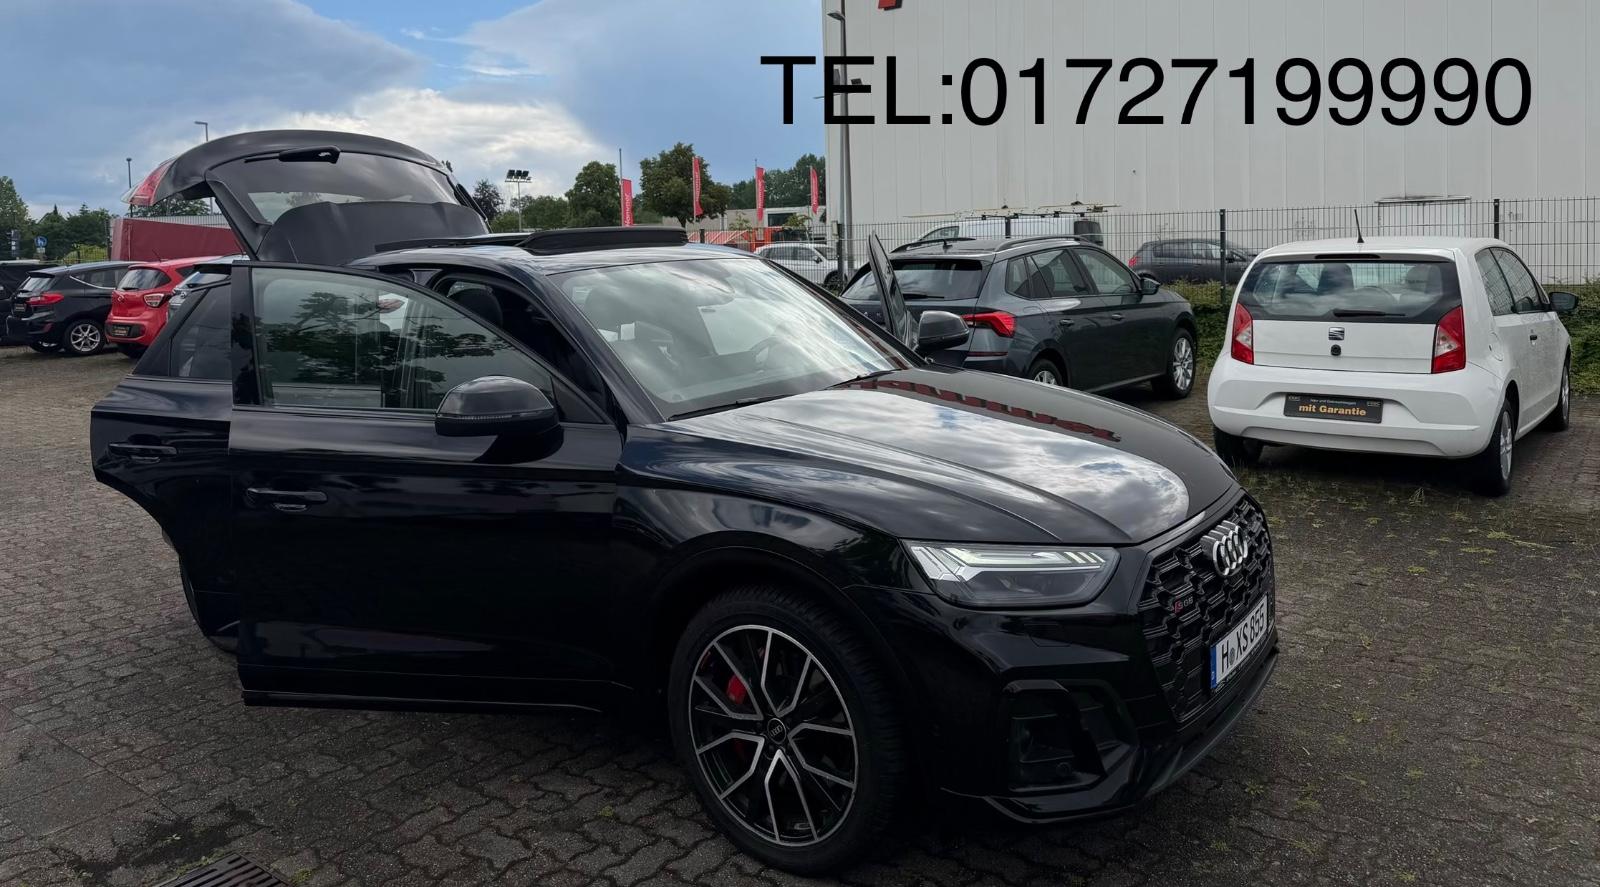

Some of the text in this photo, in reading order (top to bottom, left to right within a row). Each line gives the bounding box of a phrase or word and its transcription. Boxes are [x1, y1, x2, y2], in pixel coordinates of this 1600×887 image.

[1299, 404, 1367, 416] mit Garantie
[1221, 602, 1265, 673] H XS 855
